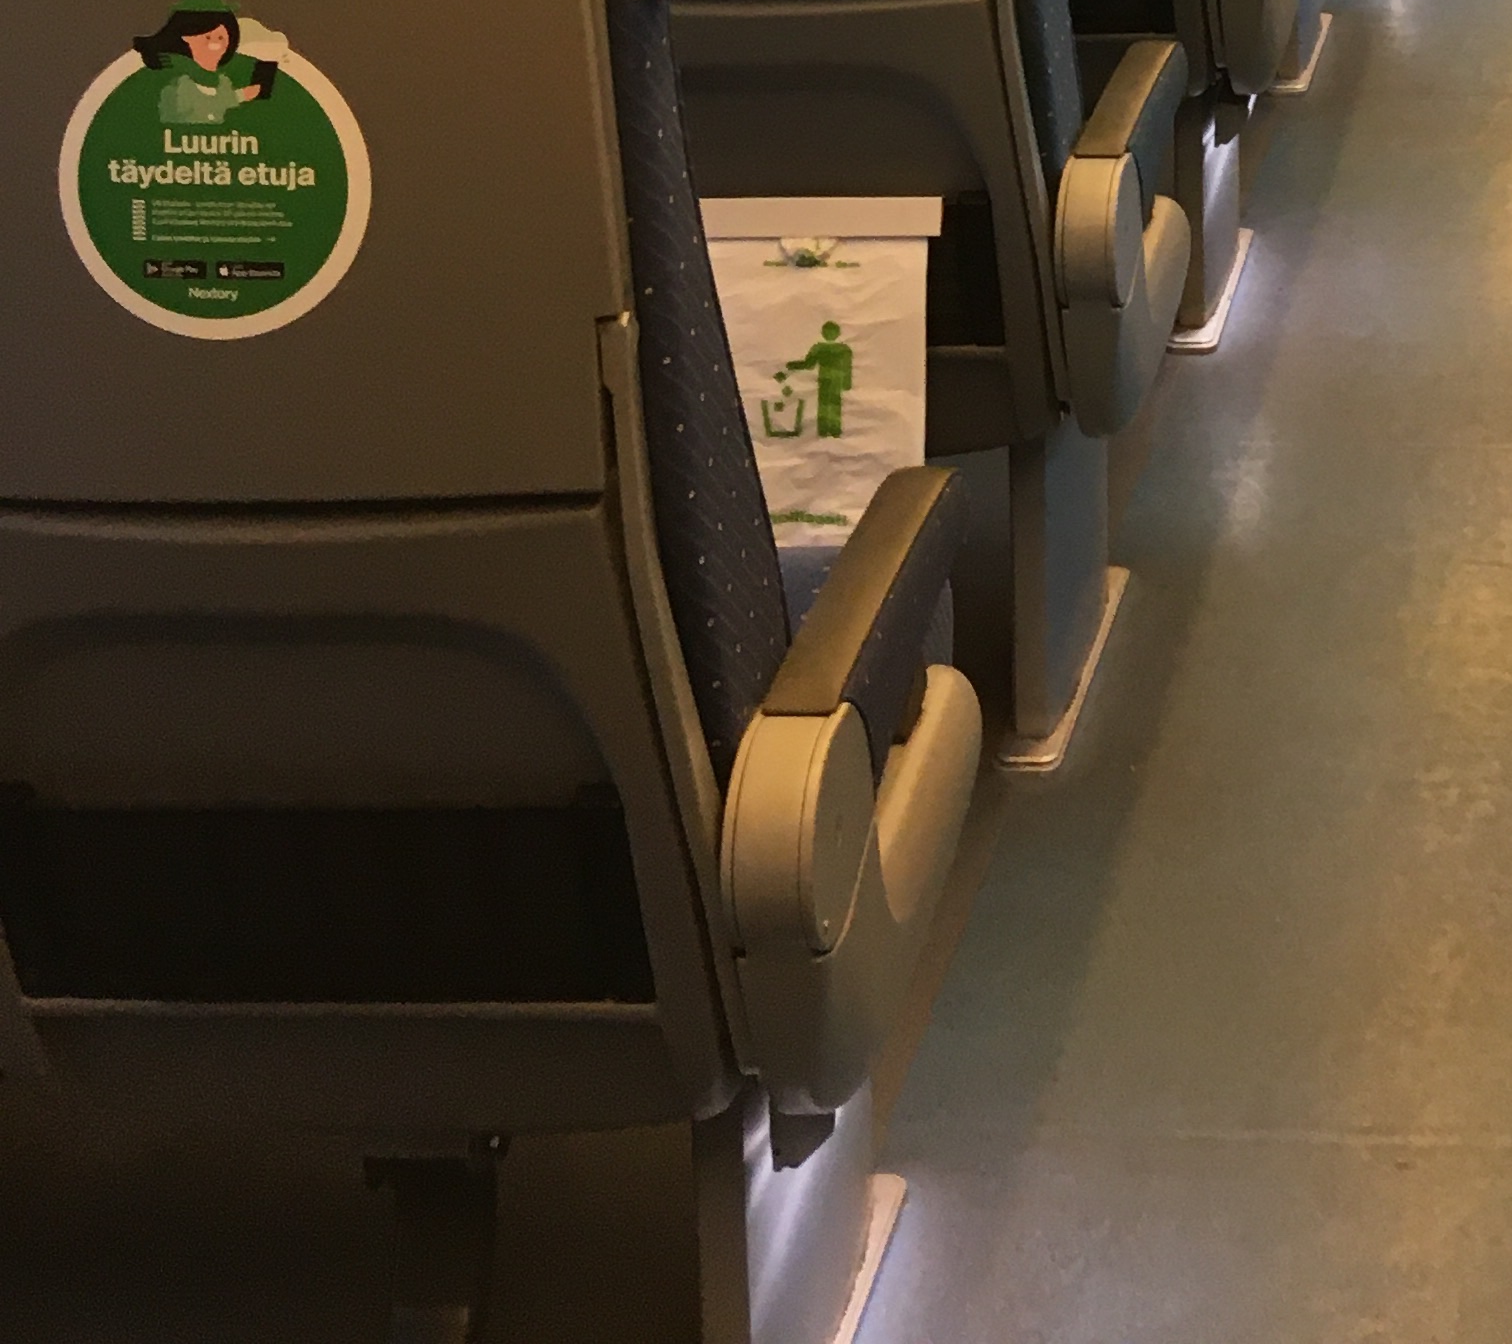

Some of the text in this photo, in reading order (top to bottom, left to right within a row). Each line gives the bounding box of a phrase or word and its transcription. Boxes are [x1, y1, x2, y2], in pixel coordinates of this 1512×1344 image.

[163, 128, 258, 155] Luurin
[107, 159, 316, 191] täydeltä etuja
